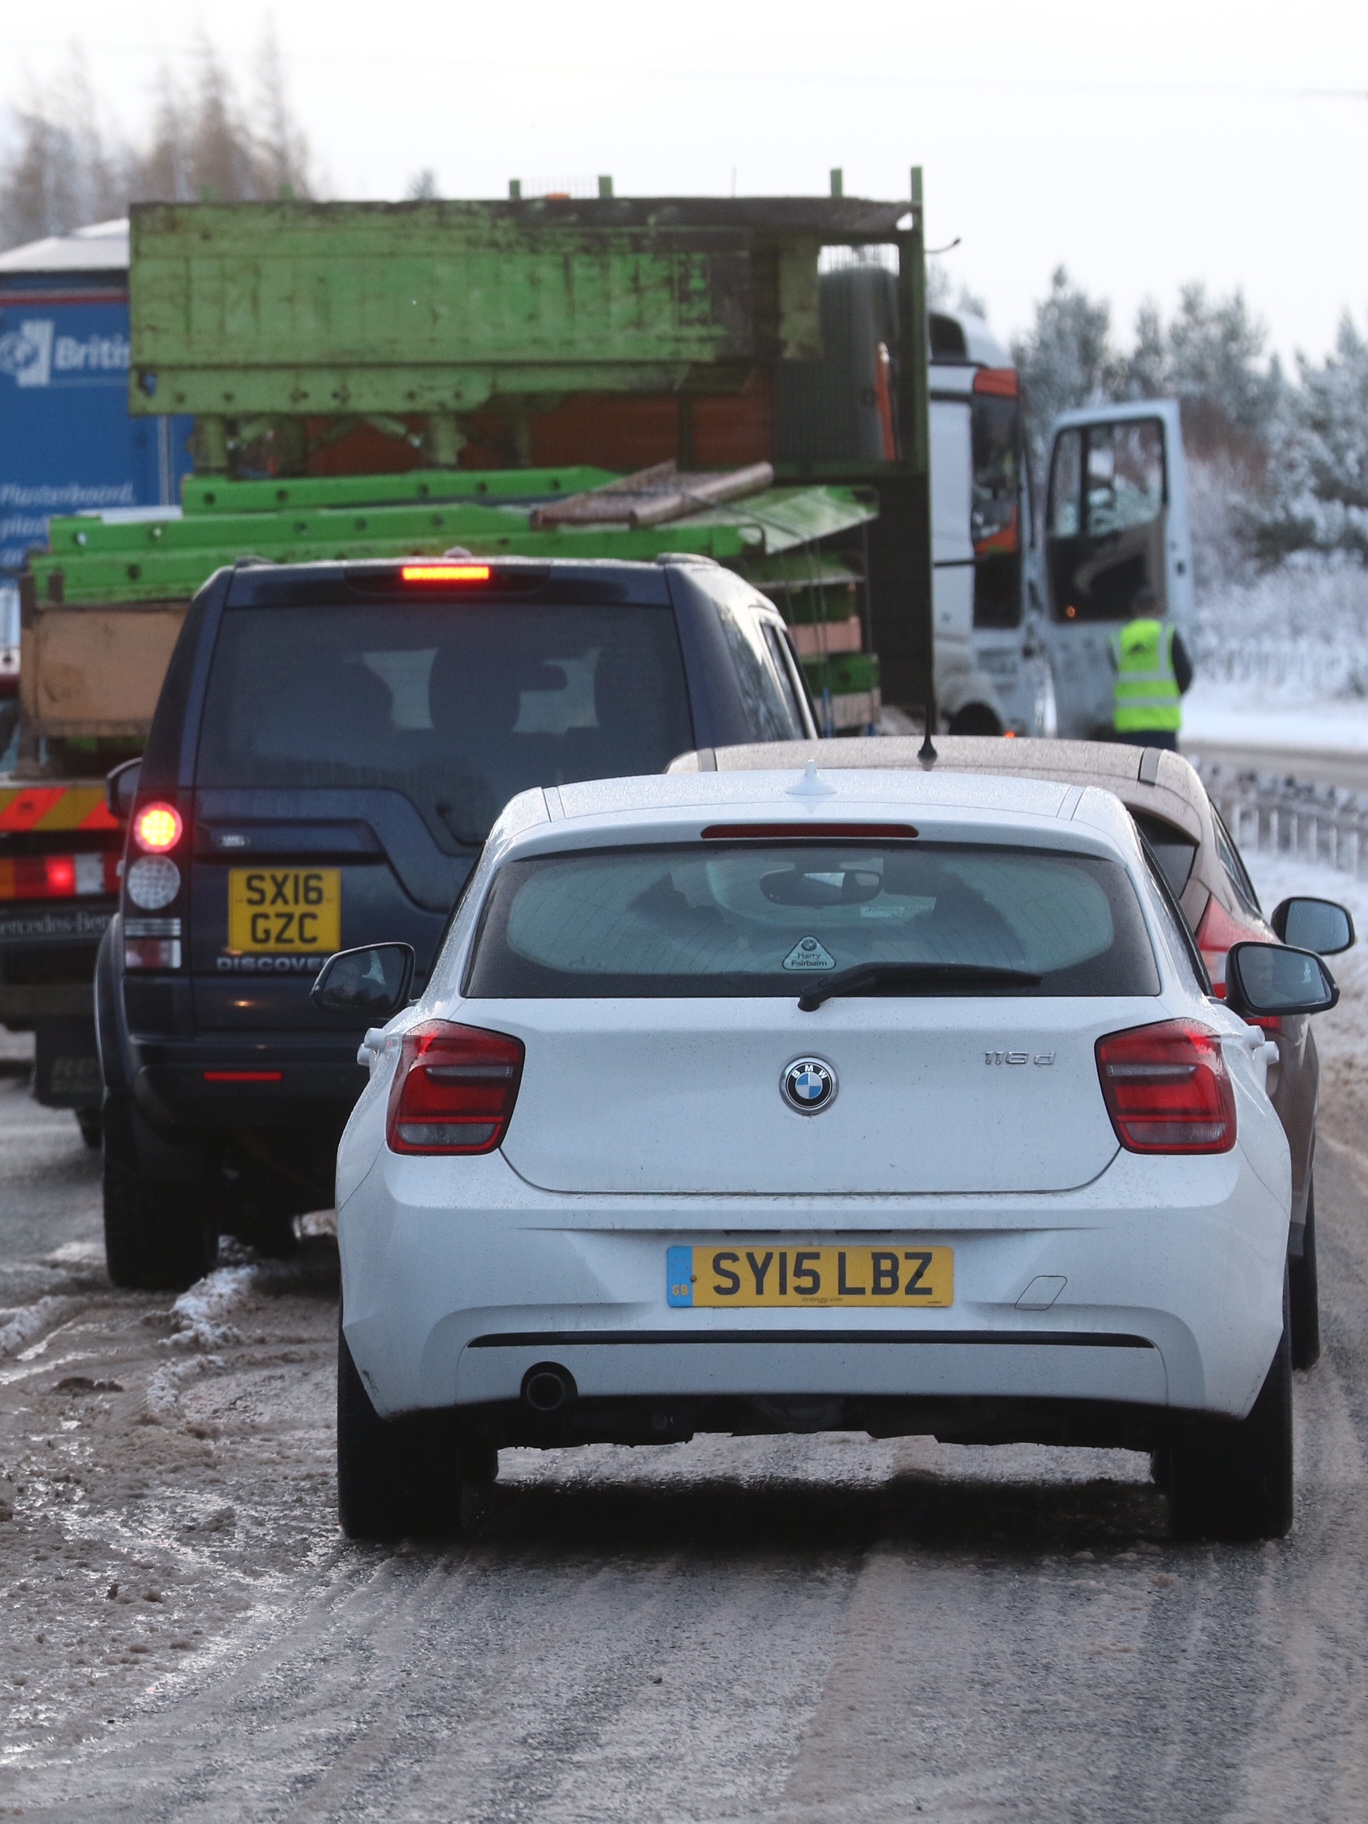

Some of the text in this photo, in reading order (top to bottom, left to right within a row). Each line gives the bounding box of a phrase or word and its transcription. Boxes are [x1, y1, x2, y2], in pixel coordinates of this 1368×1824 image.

[54, 334, 130, 371] Britis
[246, 874, 324, 906] SX16
[251, 912, 319, 944] GZC
[217, 957, 329, 971] DISCOVE
[797, 952, 821, 960] Harry
[792, 1064, 828, 1079] BMW
[712, 1252, 933, 1295] SY15 LBZ
